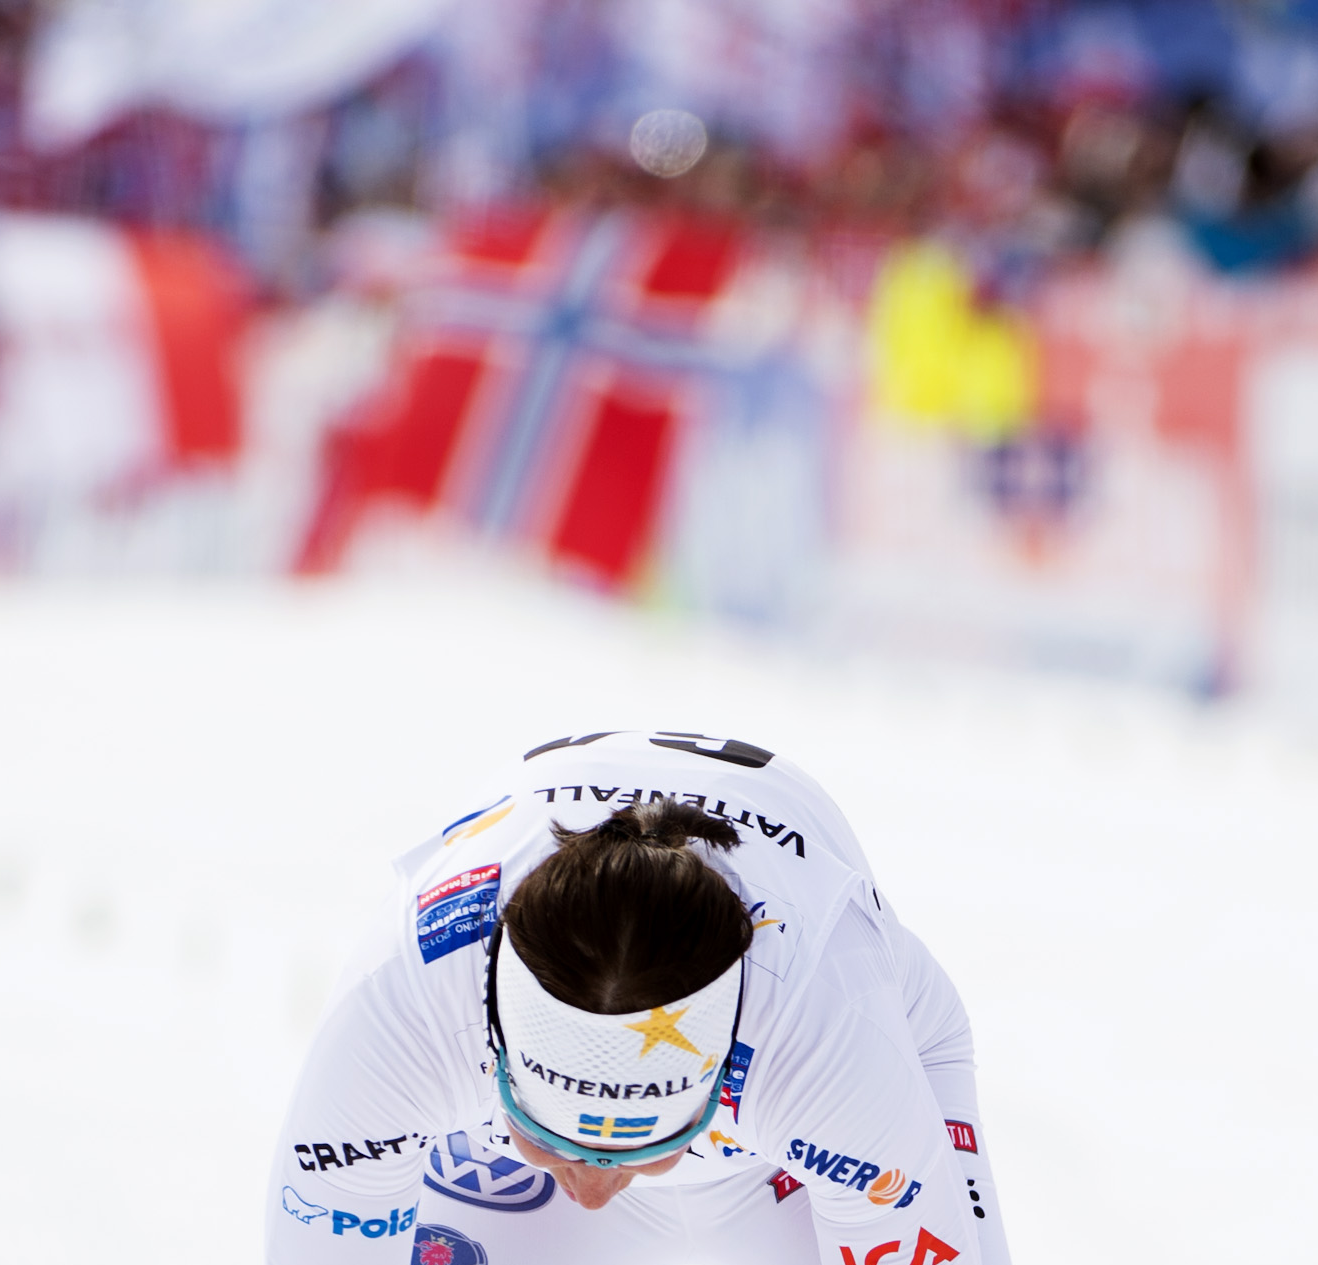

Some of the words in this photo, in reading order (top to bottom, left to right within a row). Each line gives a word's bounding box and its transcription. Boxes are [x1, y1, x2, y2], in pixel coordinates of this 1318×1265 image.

[534, 785, 806, 859] VATTENFALL
[421, 929, 452, 951] 2013
[455, 911, 496, 933] TRNTINO
[520, 1050, 694, 1100] VATTENFALL
[294, 1135, 407, 1171] CRAFT
